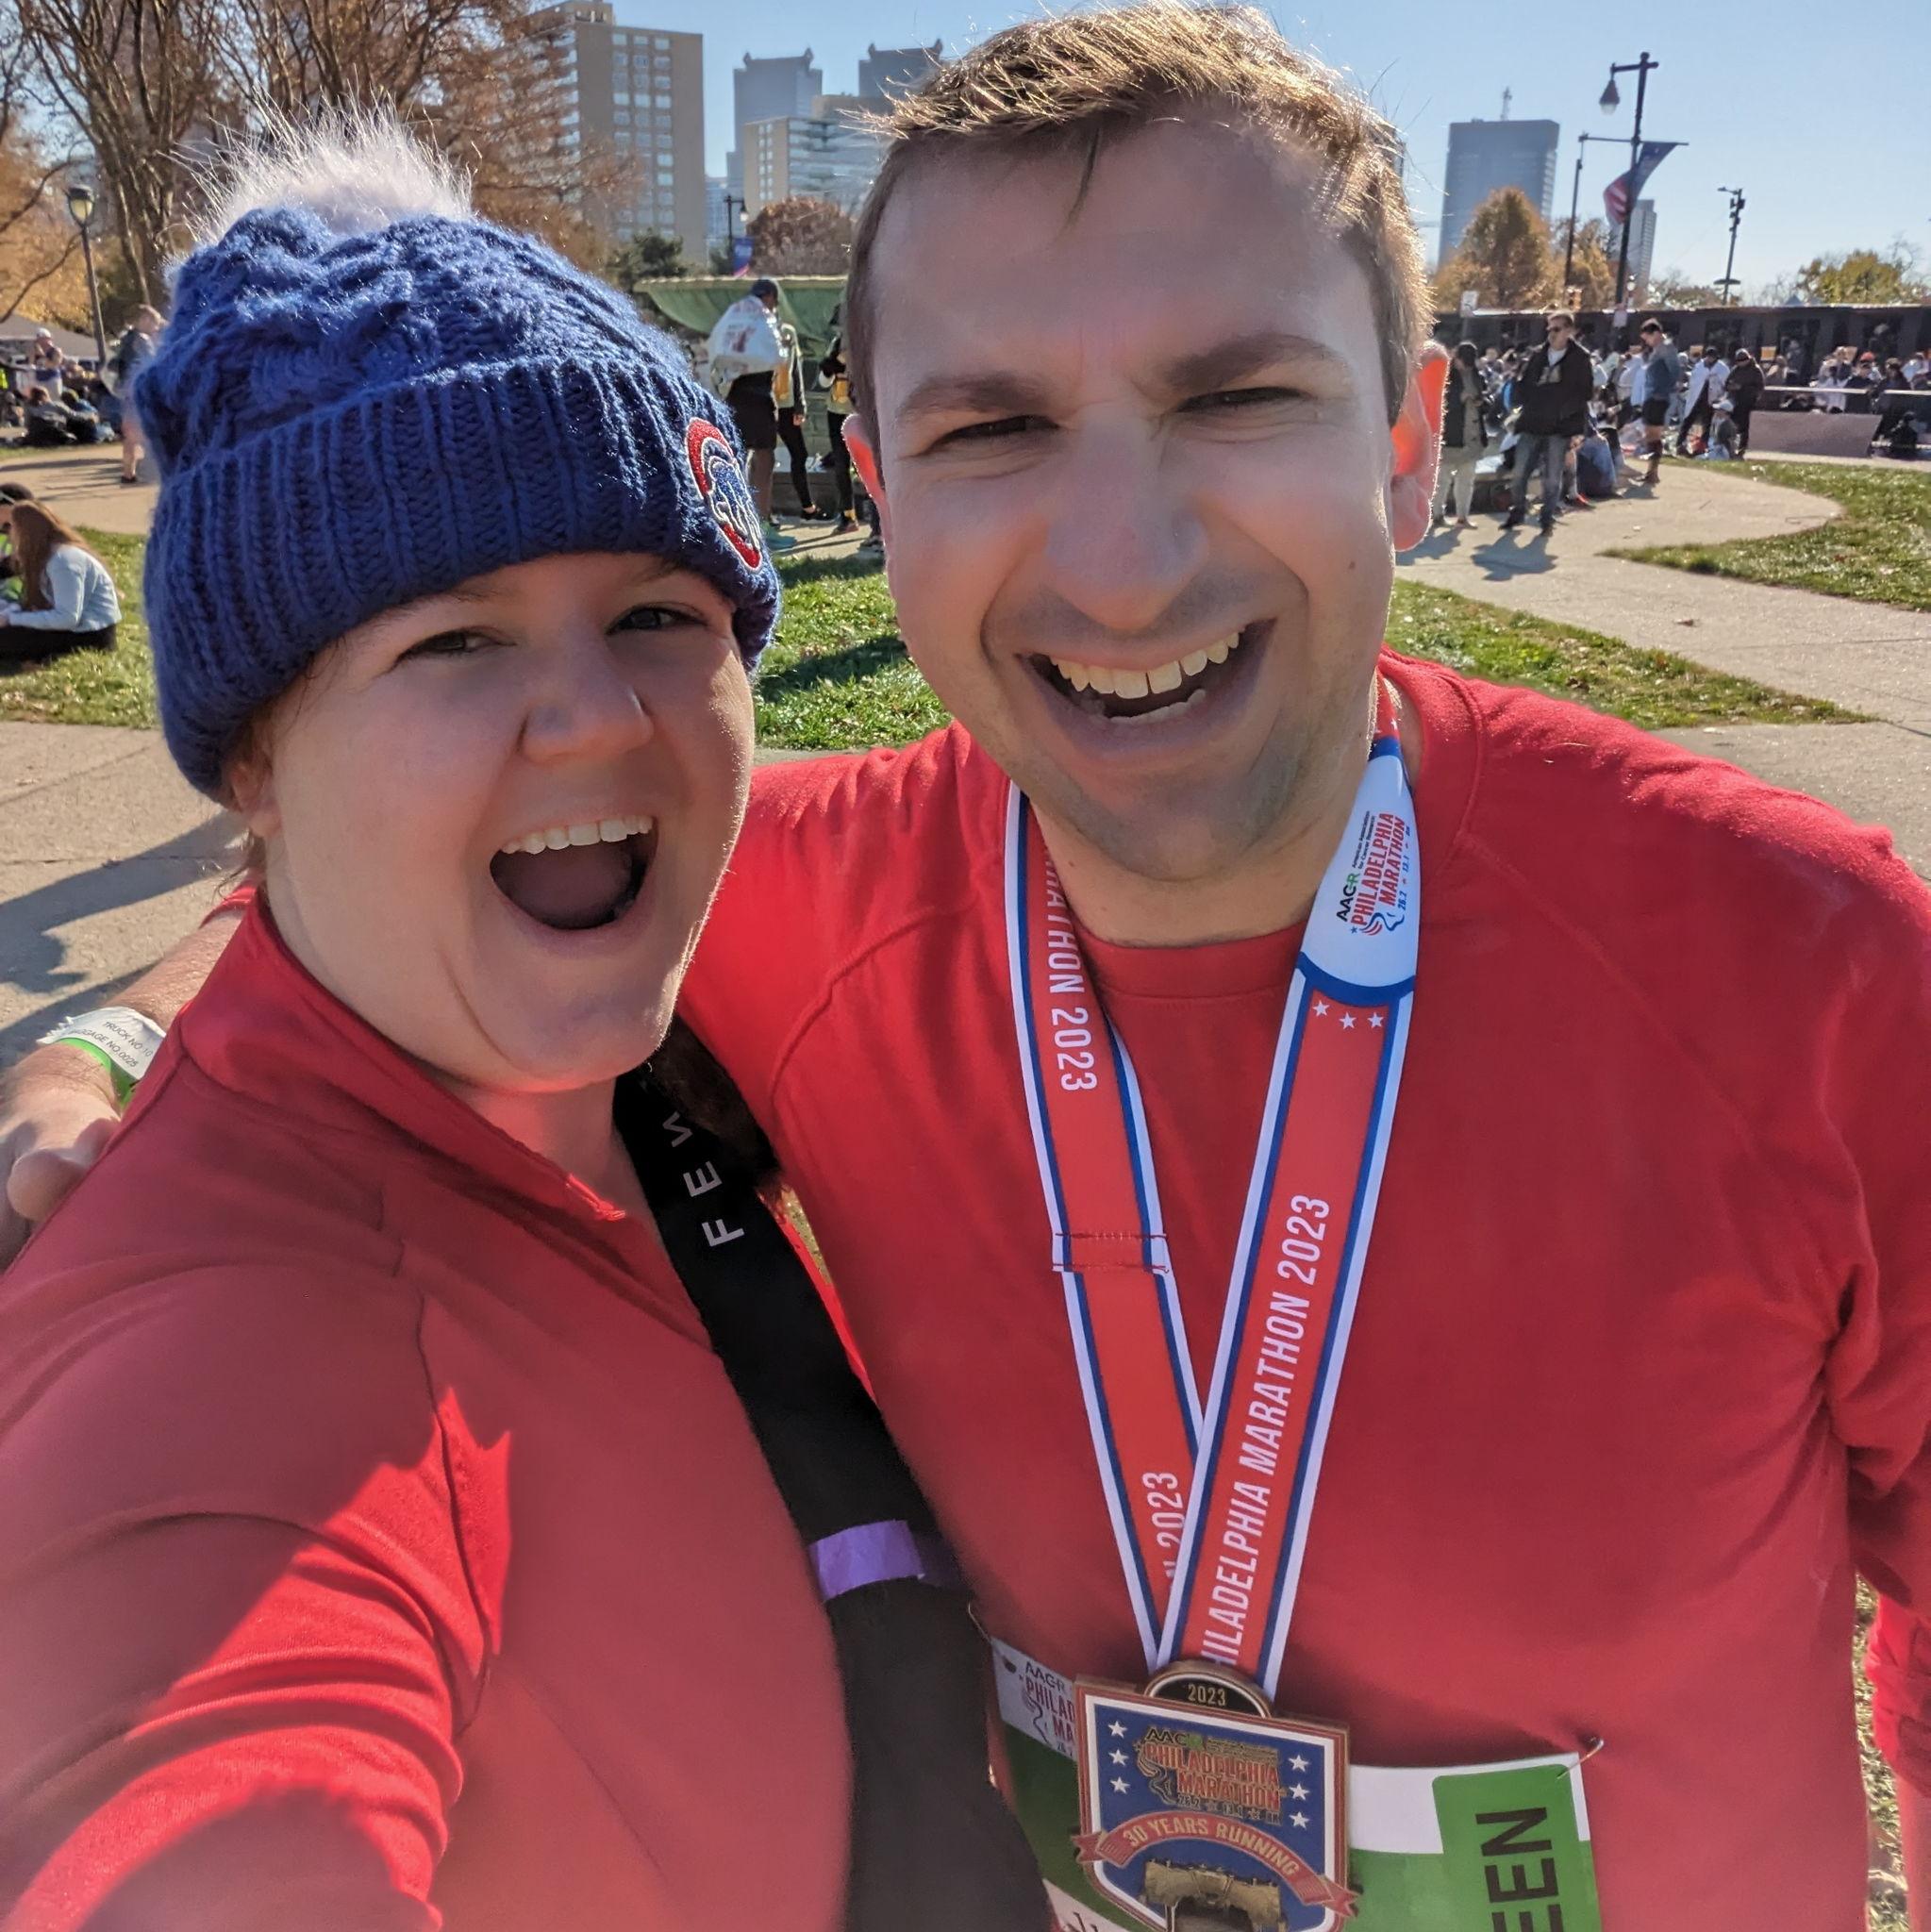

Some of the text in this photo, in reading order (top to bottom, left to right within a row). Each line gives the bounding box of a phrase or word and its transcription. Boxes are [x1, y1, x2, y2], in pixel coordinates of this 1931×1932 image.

[1350, 812, 1394, 926] PHILADELPHIA
[1378, 815, 1406, 907] MARATHON
[103, 1022, 132, 1041] TRUCK
[1051, 1006, 1098, 1091] 2023
[1238, 1291, 1310, 1476] MARATHON
[1276, 1194, 1330, 1286] 2023
[1141, 1472, 1185, 1549] 2023
[1187, 1683, 1227, 1707] 2023
[1142, 1741, 1280, 1787] PHILADELPHIA
[1176, 1769, 1282, 1812] MARATHON
[1123, 1817, 1300, 1875] 30 YEARS RUNNING
